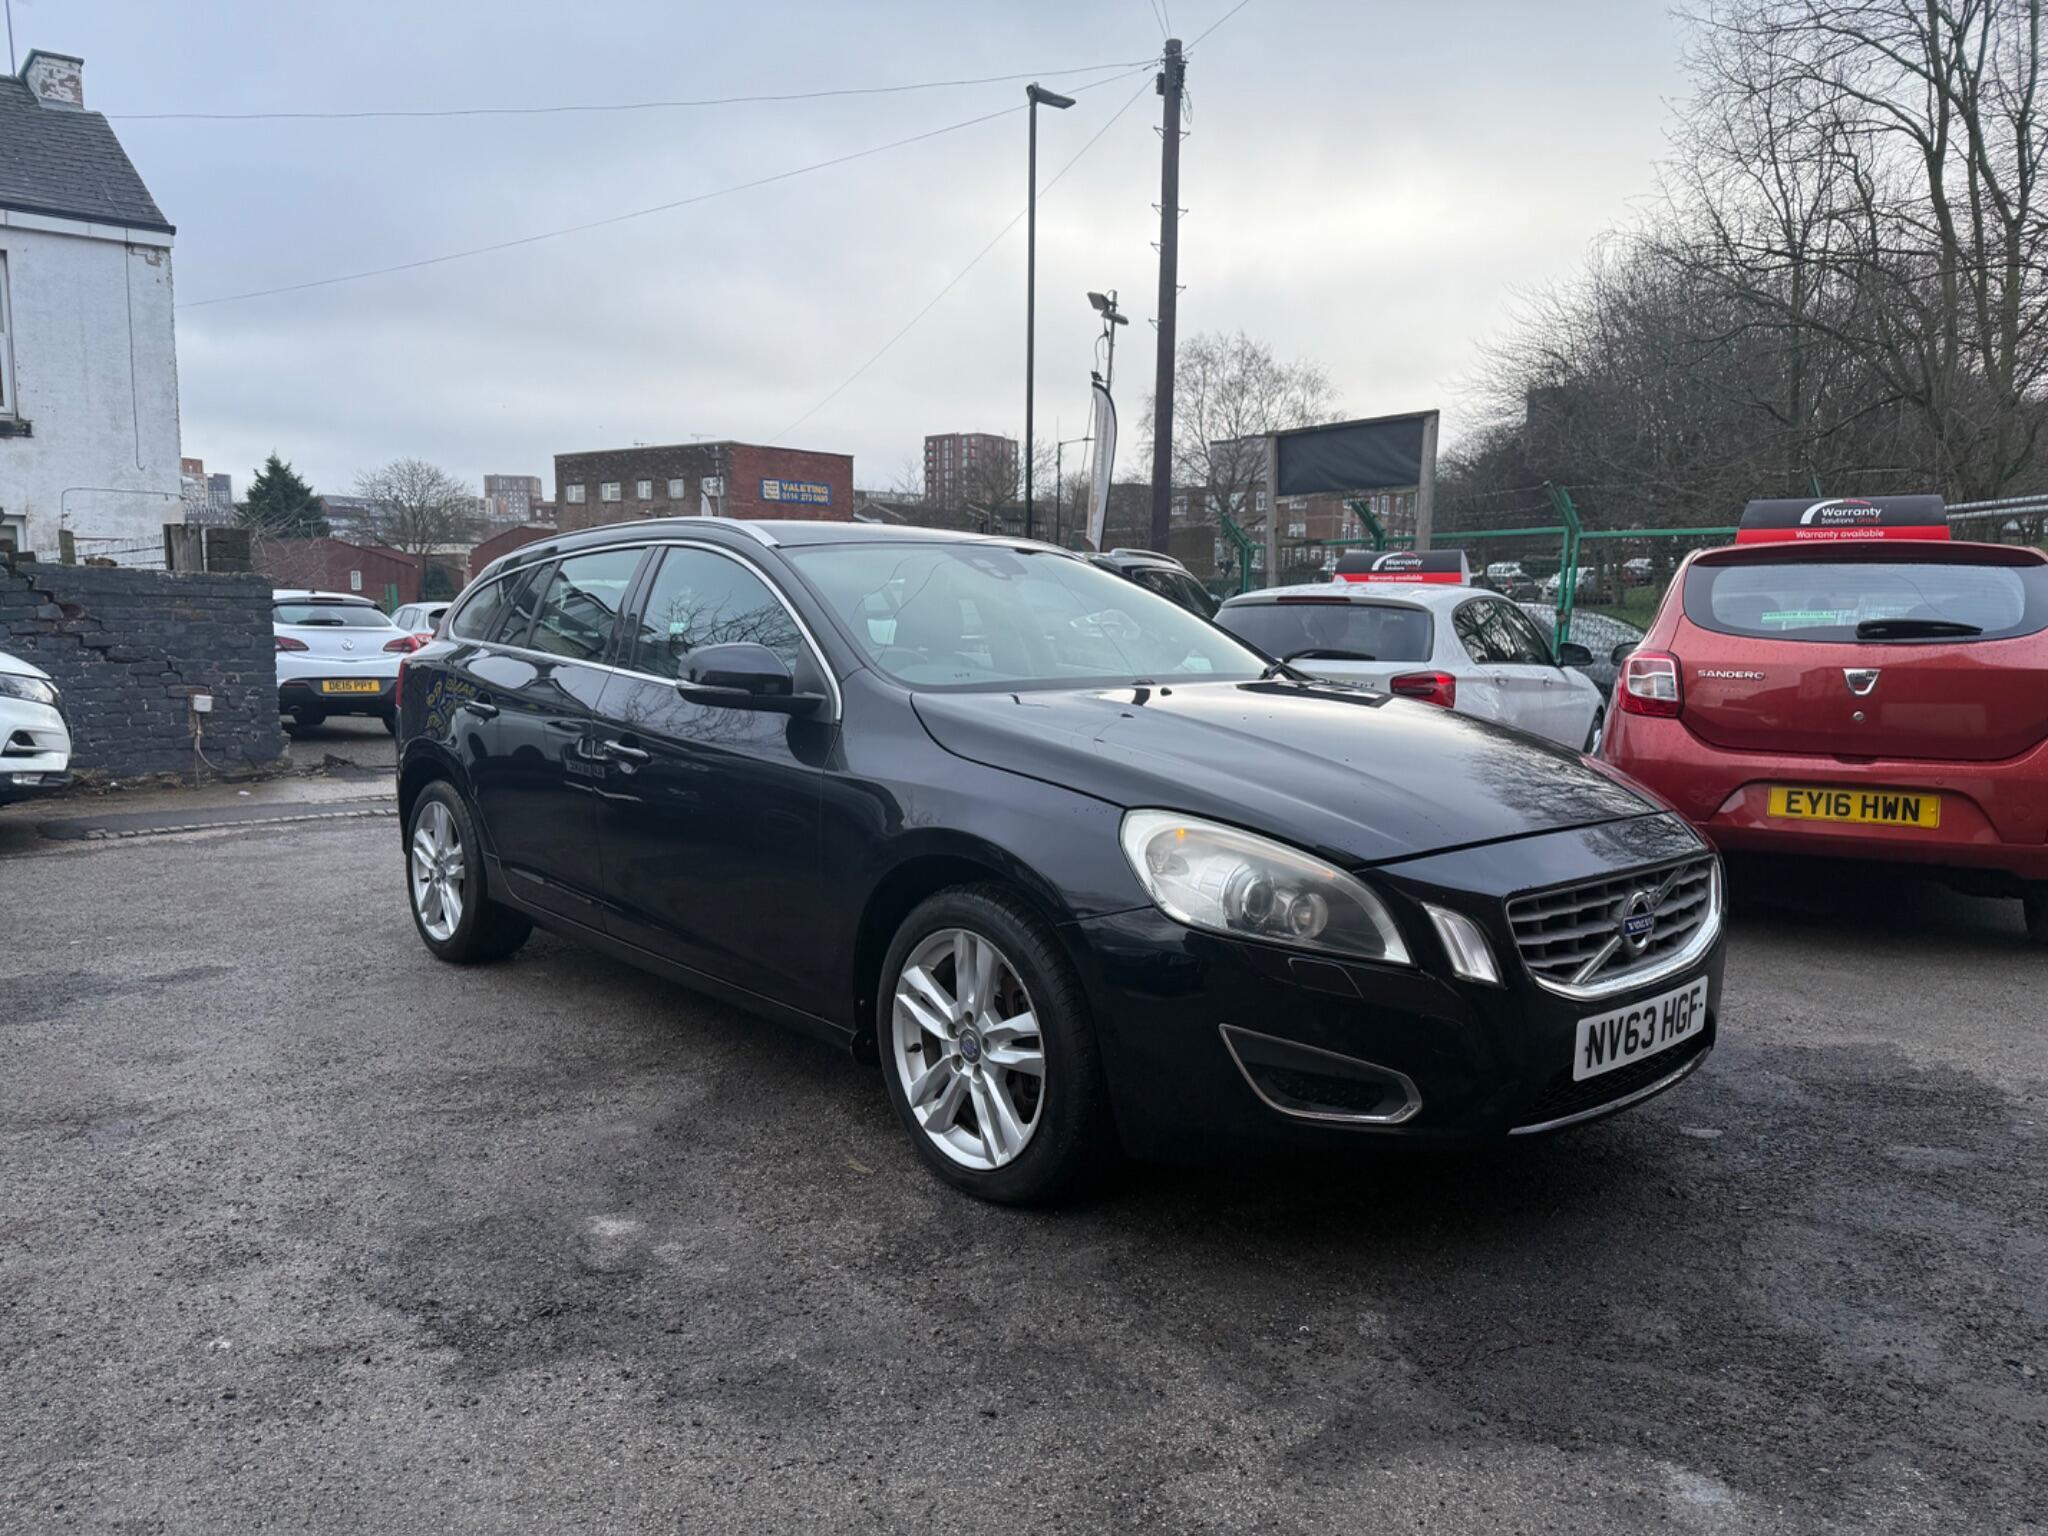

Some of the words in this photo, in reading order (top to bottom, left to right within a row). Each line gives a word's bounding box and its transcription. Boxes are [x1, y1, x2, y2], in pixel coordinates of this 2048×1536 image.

[782, 482, 828, 495] VALETING
[782, 491, 799, 500] 0114
[1821, 507, 1881, 518] Warranty
[1821, 517, 1854, 525] Solutions
[1795, 530, 1838, 540] Warranty
[1840, 528, 1885, 538] available
[1386, 559, 1423, 567] Warranty
[1697, 669, 1766, 681] SANDERO
[1785, 789, 1851, 817] EY16
[1860, 794, 1921, 823] HWN
[1585, 1005, 1657, 1069] NV63
[1660, 986, 1702, 1043] HGF
